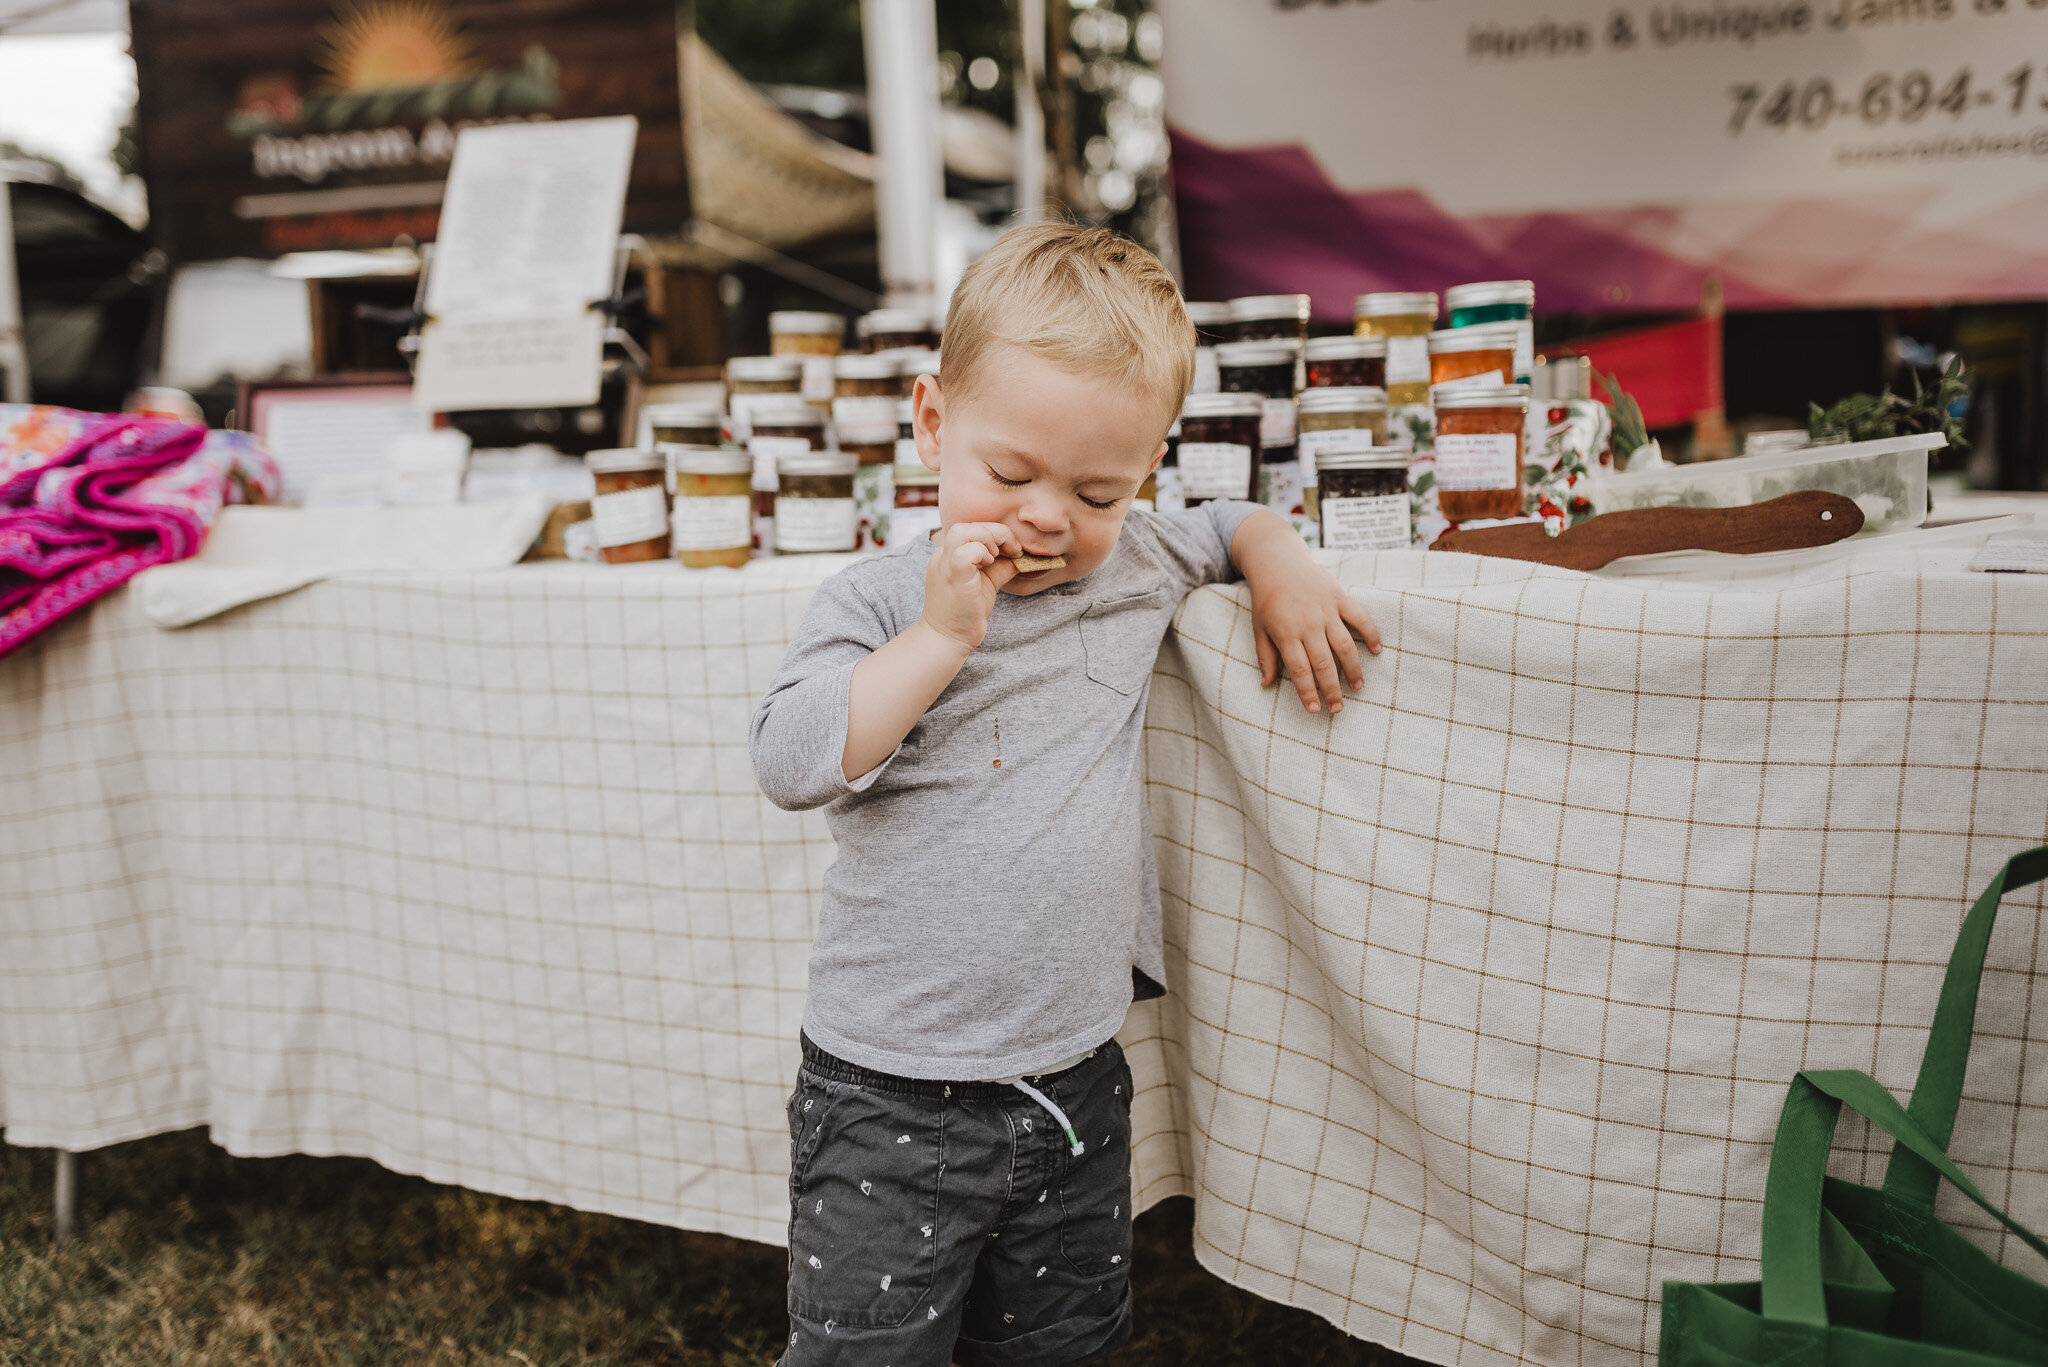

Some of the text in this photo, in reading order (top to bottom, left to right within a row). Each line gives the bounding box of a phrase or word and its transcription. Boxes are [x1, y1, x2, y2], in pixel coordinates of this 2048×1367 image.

[1468, 19, 1592, 59] Herbs
[1606, 9, 1637, 49] &
[1650, 0, 1811, 48] Unique
